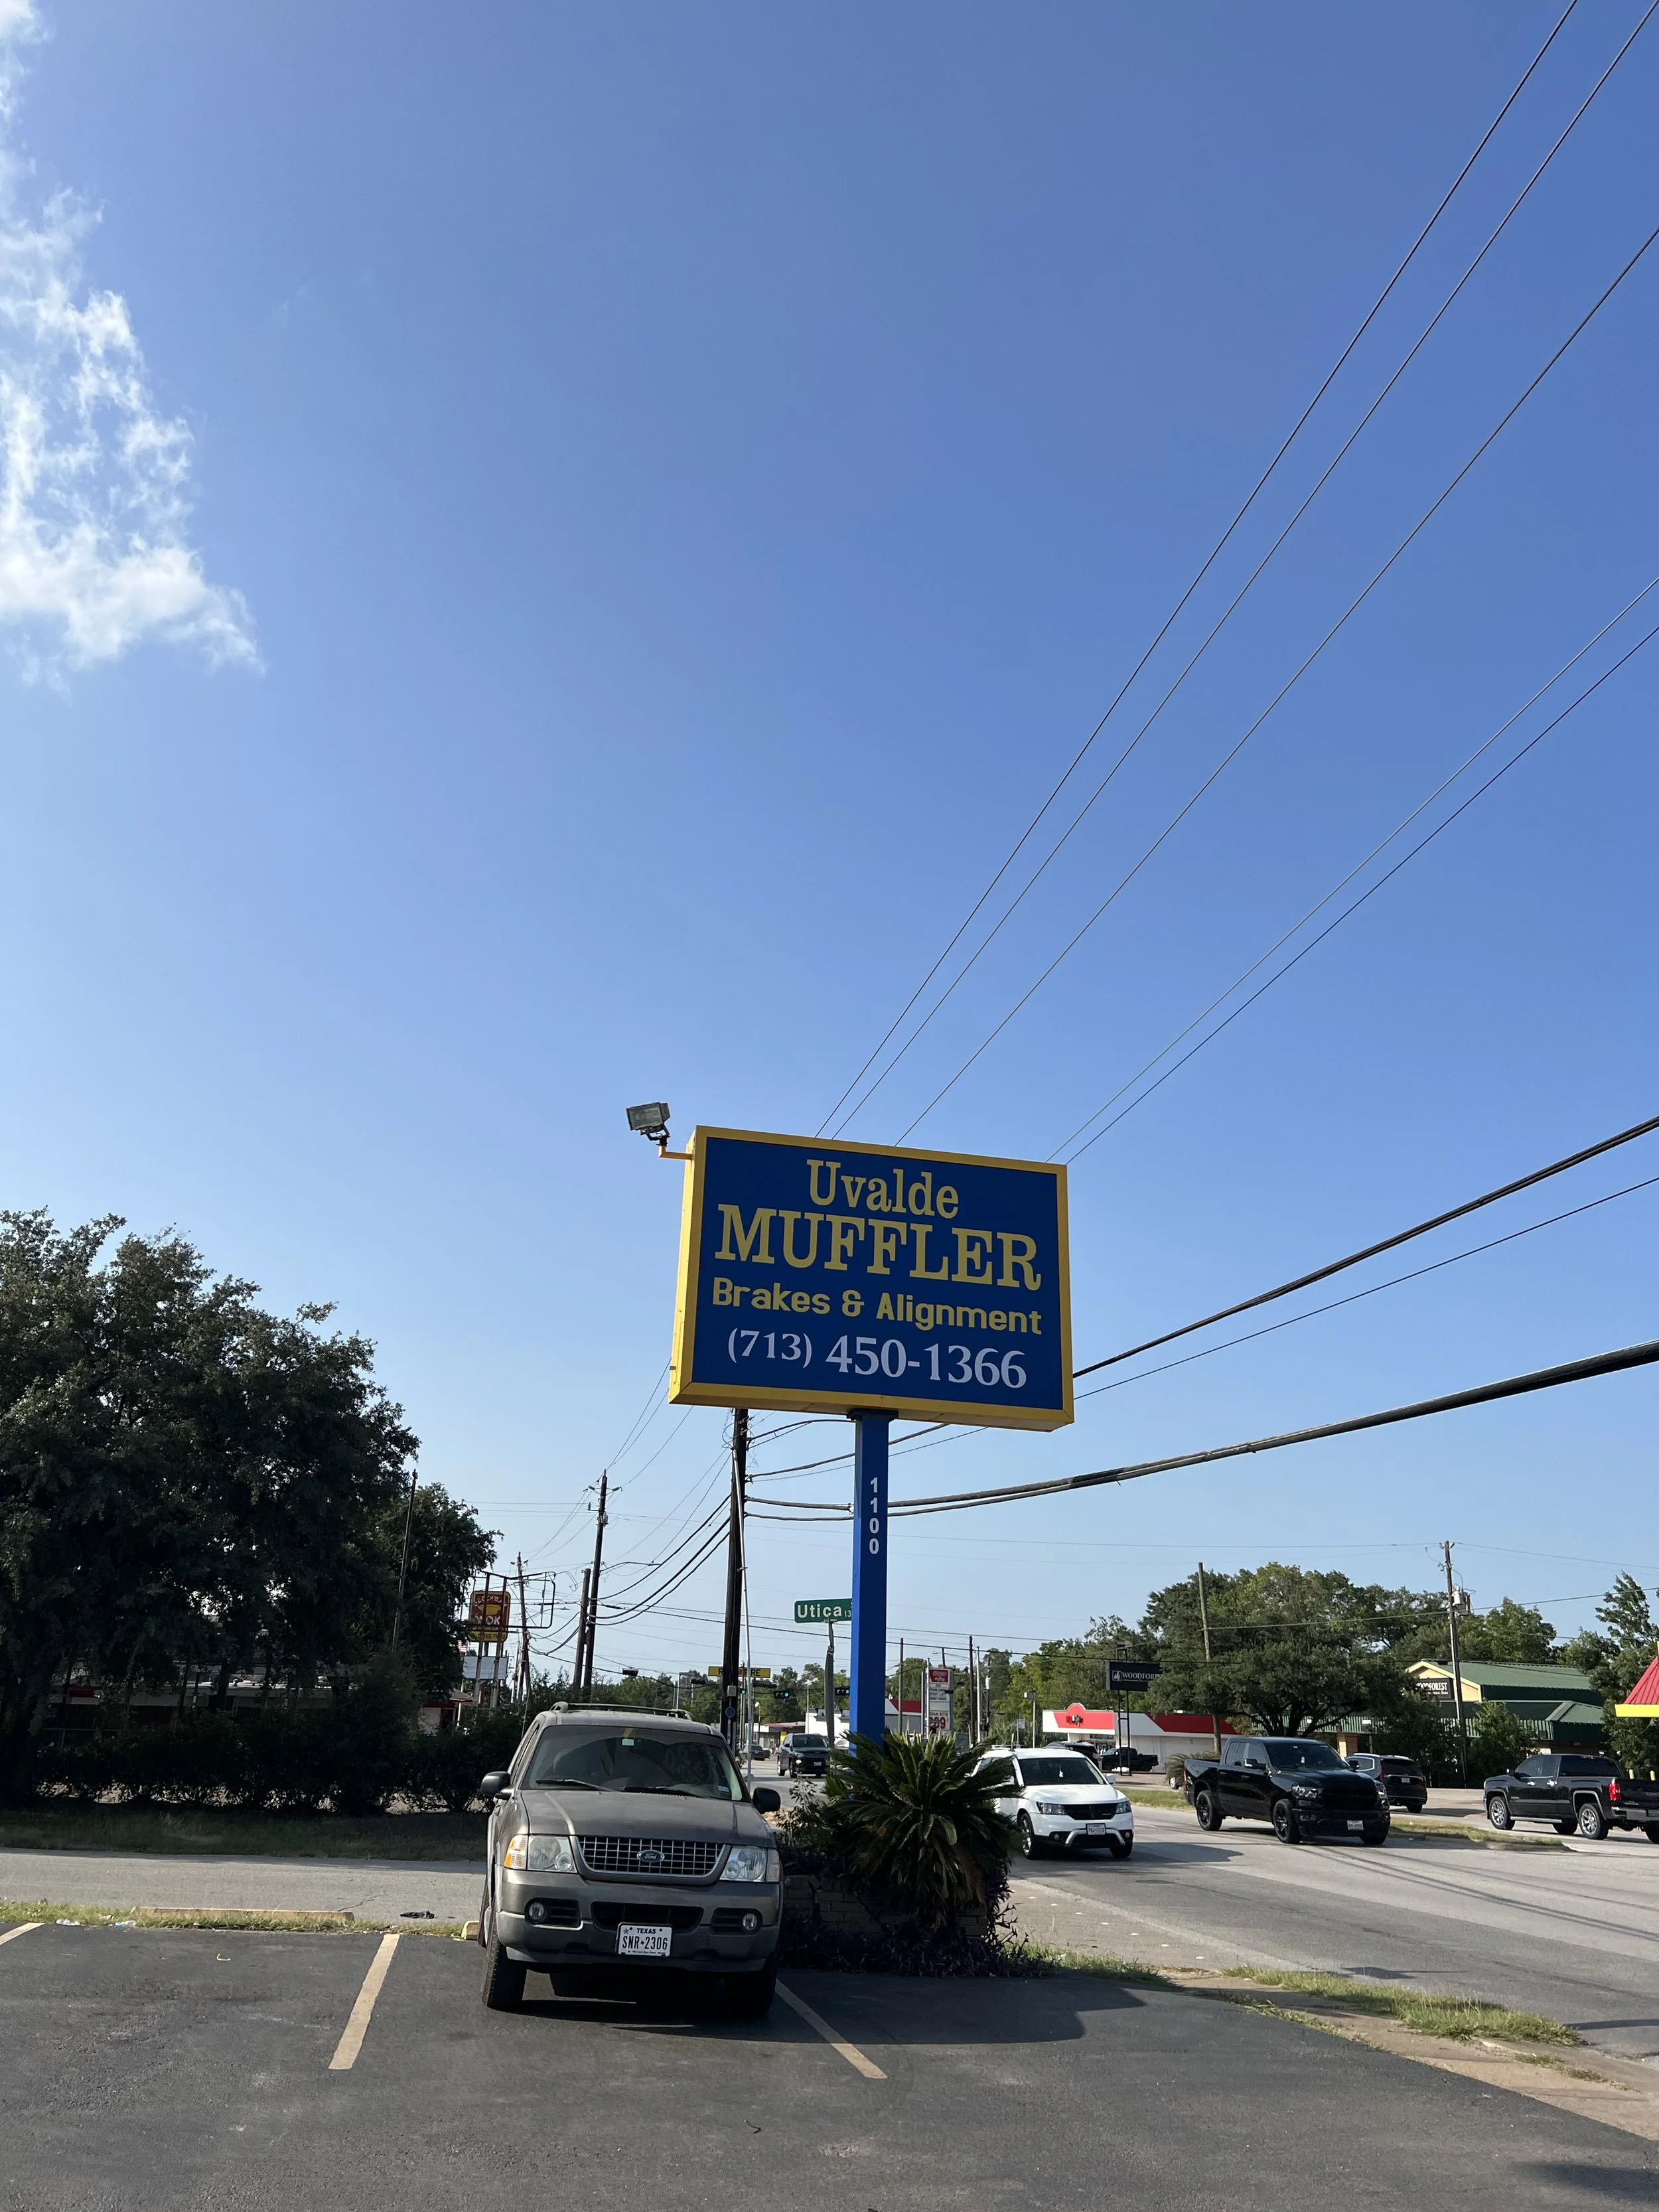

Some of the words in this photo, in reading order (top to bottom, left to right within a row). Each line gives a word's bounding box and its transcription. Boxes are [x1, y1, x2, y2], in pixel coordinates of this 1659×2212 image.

[806, 1159, 960, 1219] Uvalde
[714, 1203, 1043, 1291] MUFFLER
[712, 1277, 831, 1315] Brakes
[842, 1290, 865, 1317] &
[877, 1291, 1043, 1336] Alignment
[727, 1327, 813, 1369] (713)
[826, 1335, 1027, 1390] 450-1366
[869, 1477, 880, 1555] 1100
[797, 1603, 842, 1619] Utica
[1415, 1682, 1448, 1691] OODFOREST
